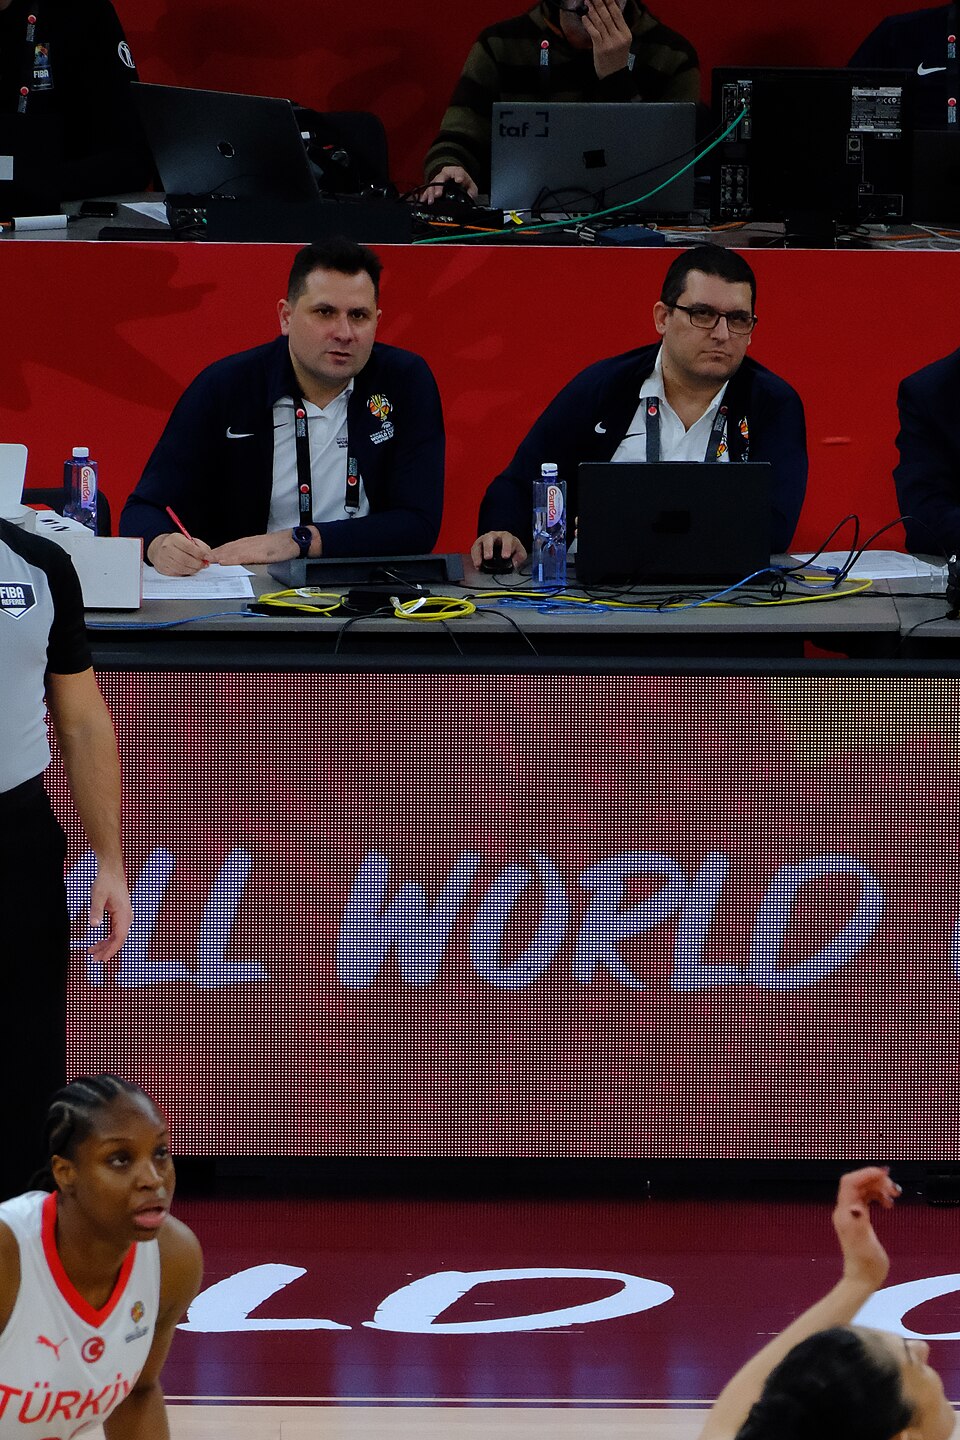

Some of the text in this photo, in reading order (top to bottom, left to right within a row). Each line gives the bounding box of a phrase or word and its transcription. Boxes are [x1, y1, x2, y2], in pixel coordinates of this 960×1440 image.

[33, 69, 50, 79] FIBA
[499, 122, 529, 137] taf
[0, 586, 25, 598] FIBA
[336, 849, 888, 992] WORLD
